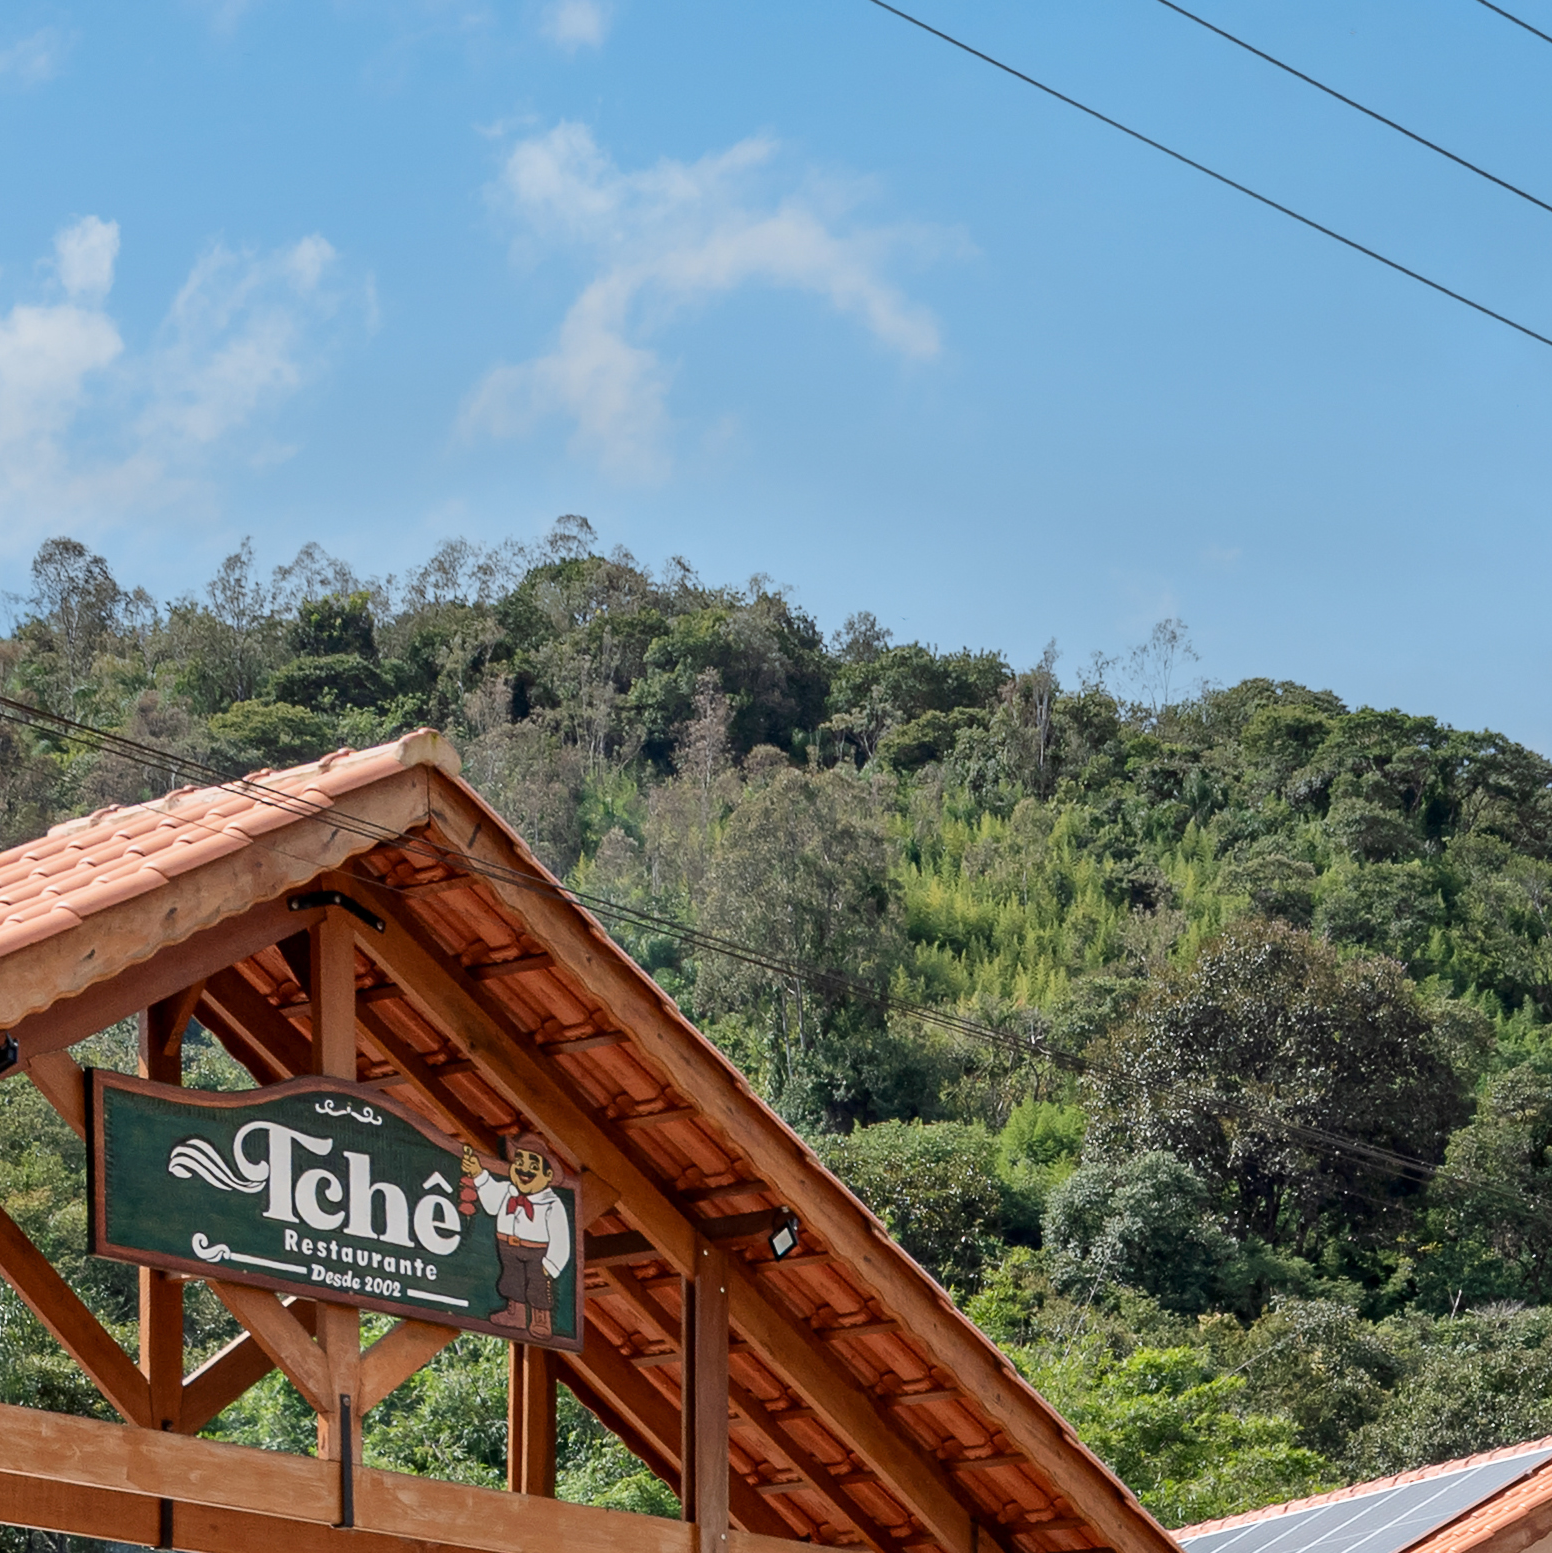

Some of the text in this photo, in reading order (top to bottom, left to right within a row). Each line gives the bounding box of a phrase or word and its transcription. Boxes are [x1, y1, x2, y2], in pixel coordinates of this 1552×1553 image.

[232, 1120, 462, 1256] Tchê
[283, 1228, 438, 1282] Restaurante
[310, 1264, 402, 1298] Desde 2002
